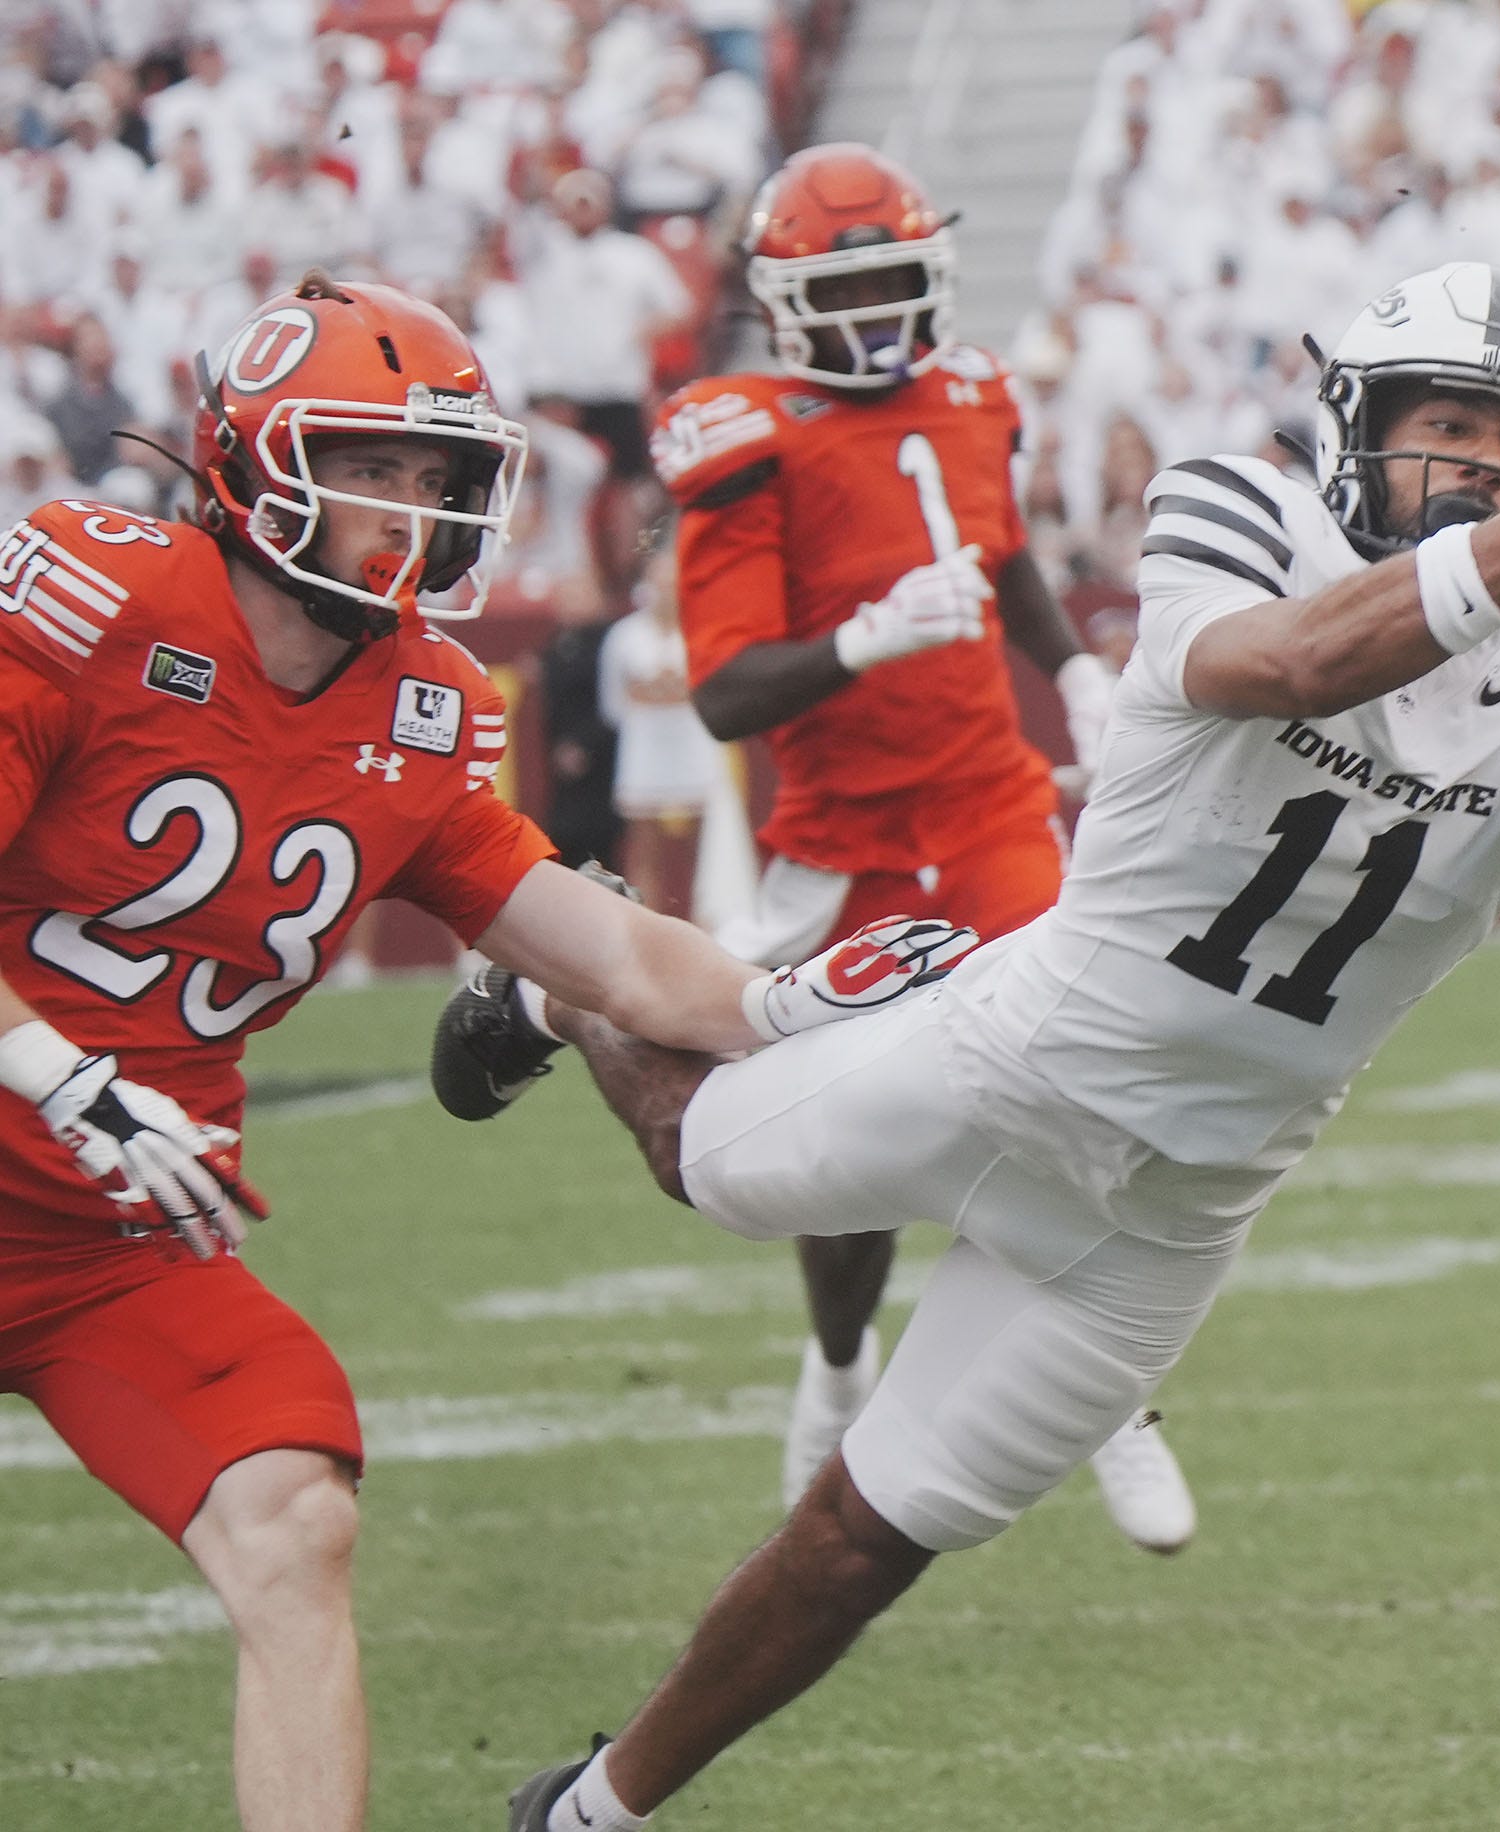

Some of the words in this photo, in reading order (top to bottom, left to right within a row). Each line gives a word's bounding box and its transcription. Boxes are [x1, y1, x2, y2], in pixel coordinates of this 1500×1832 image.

[397, 719, 454, 742] HEALTH
[1274, 719, 1375, 790] IOWA
[1372, 773, 1499, 818] STATE
[29, 771, 361, 1042] 23
[1163, 788, 1431, 1027] 11
